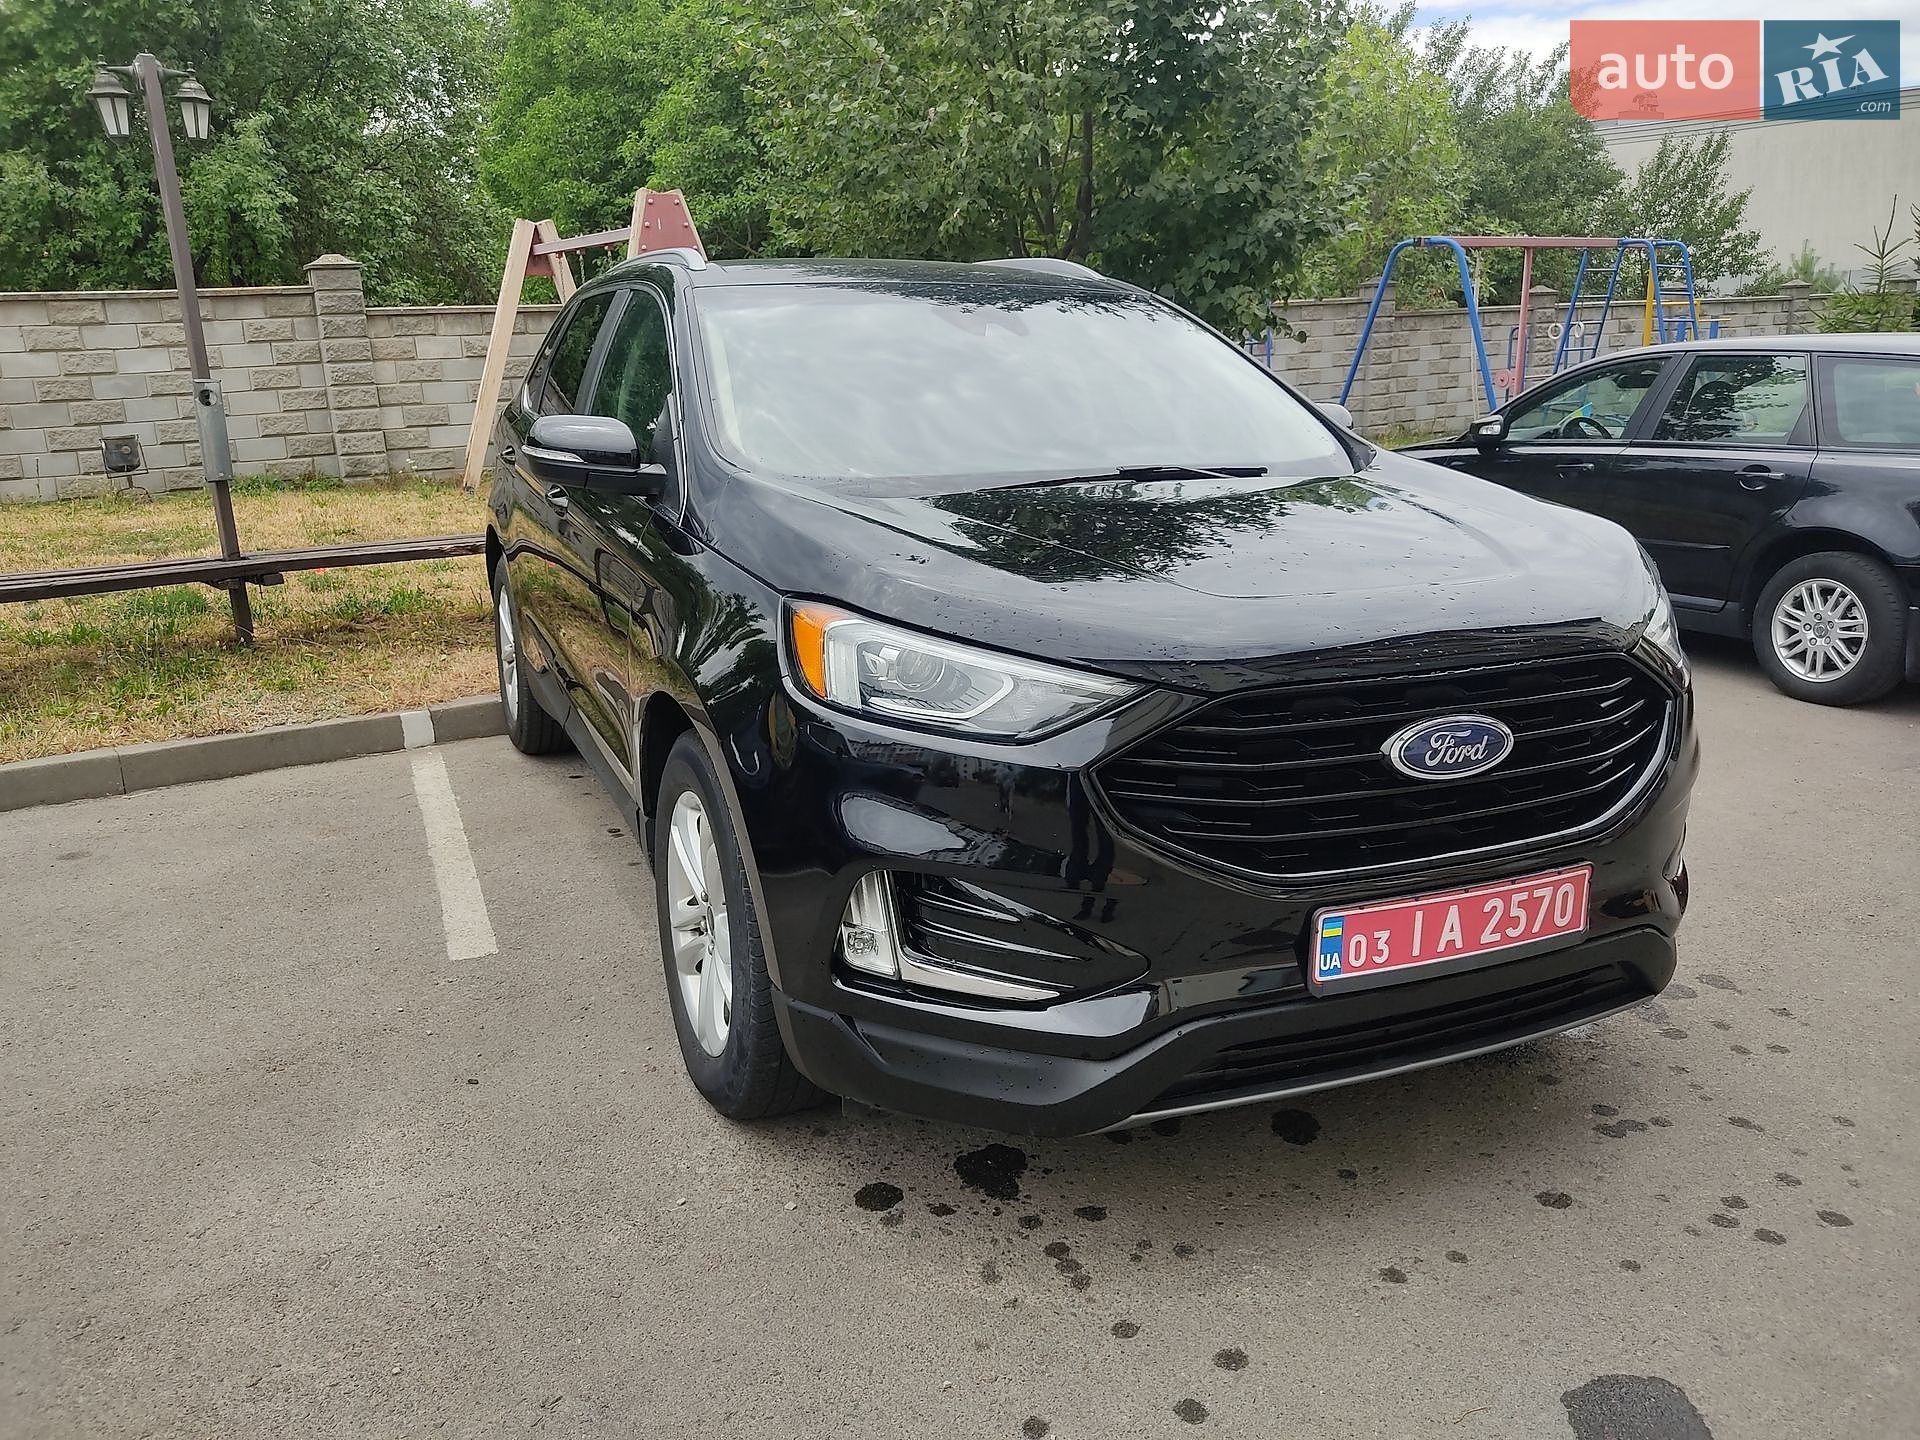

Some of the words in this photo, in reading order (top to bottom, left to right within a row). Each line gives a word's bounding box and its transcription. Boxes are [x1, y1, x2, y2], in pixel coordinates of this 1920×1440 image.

[1424, 729, 1489, 767] Ford
[1348, 930, 1391, 968] 03
[1479, 882, 1576, 945] 2570
[1320, 953, 1341, 971] UA
